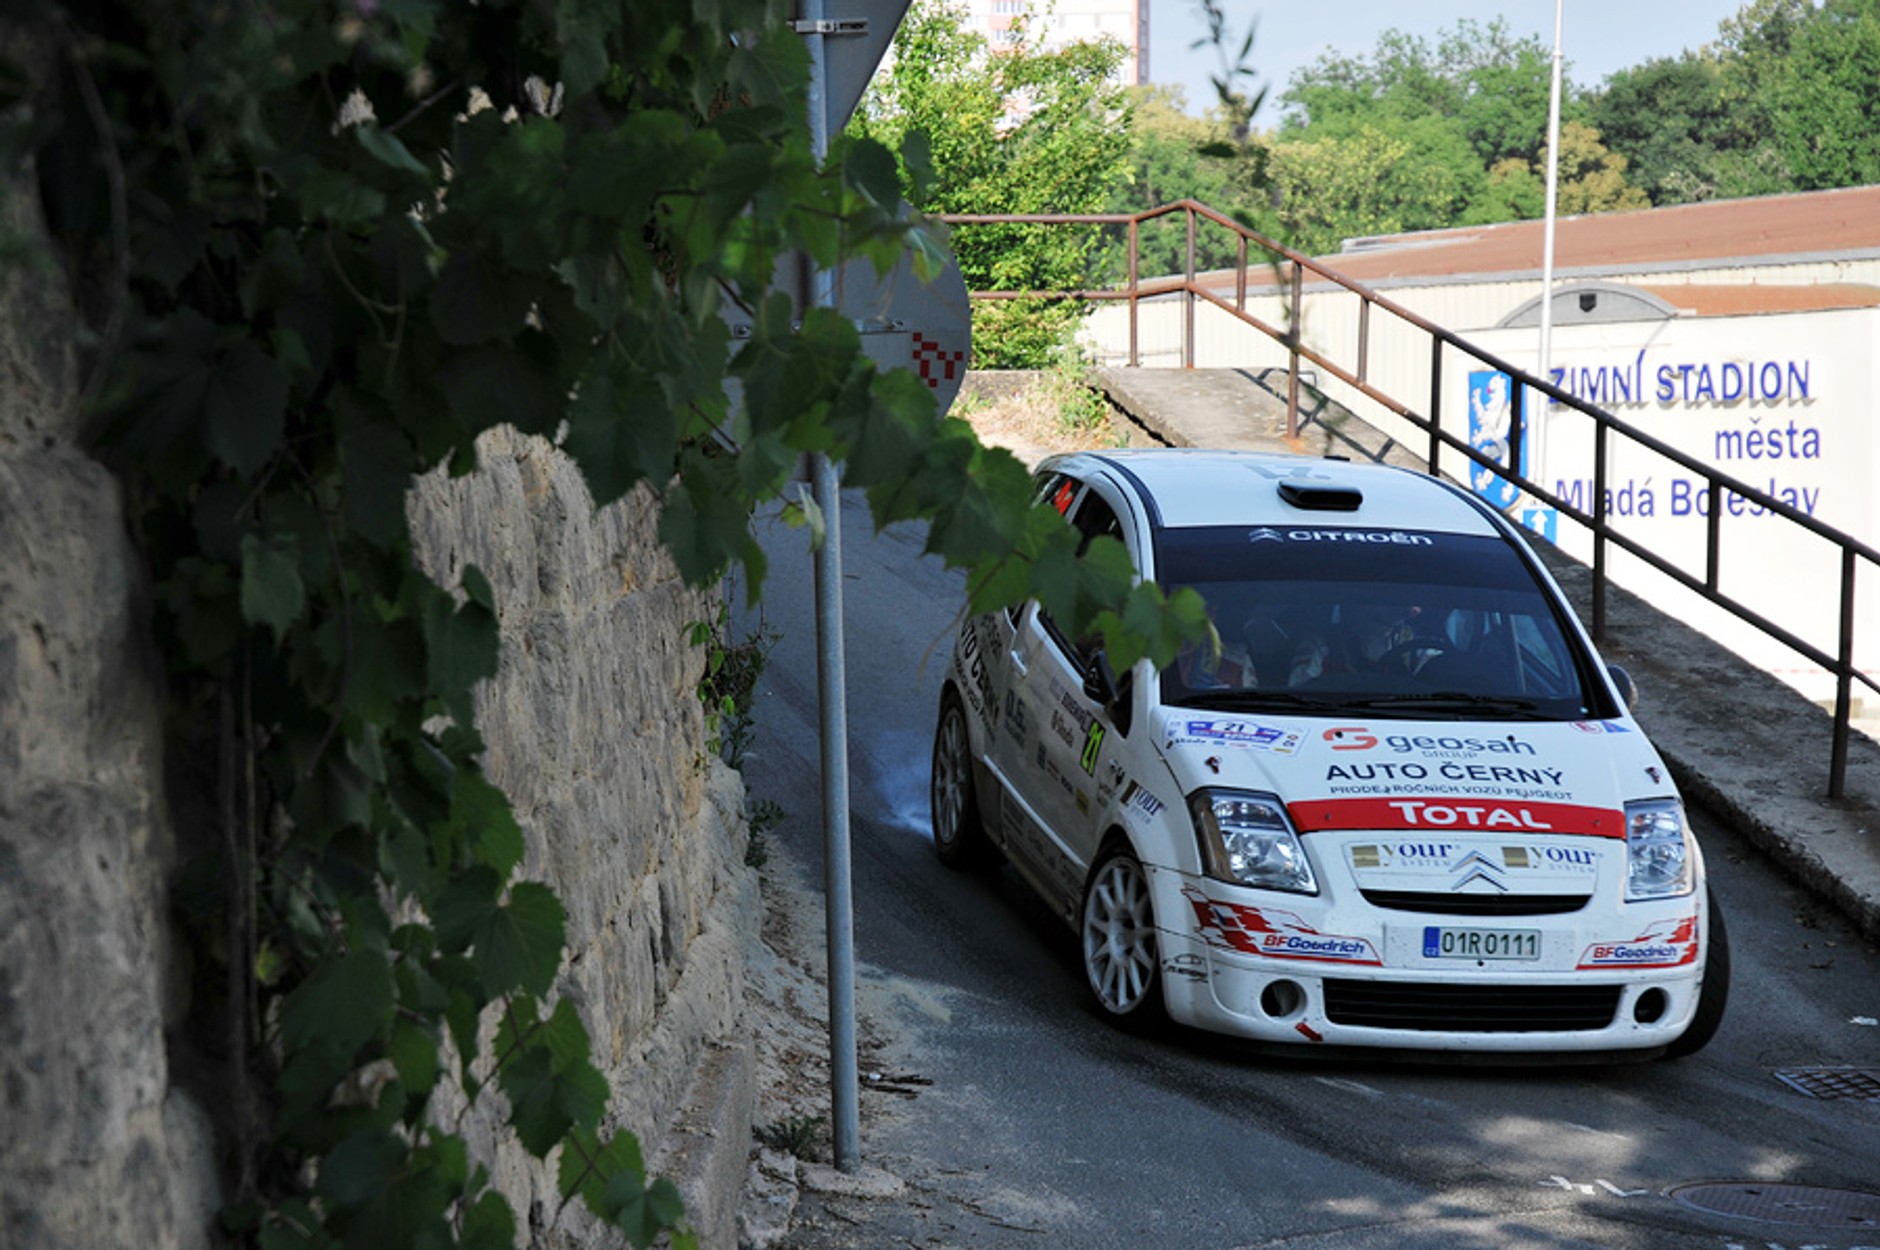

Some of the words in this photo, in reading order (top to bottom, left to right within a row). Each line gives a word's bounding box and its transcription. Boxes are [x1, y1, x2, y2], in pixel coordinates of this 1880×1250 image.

[1549, 348, 1645, 403] ZIMNÍ
[1656, 359, 1810, 401] STADION
[1715, 417, 1820, 459] města
[1224, 722, 1245, 732] 21
[1326, 763, 1428, 780] AUTO
[1440, 761, 1563, 786] ČERNÝ
[1388, 801, 1552, 829] TOTAL
[1381, 844, 1453, 867] your
[1530, 846, 1597, 869] your
[1263, 934, 1365, 954] BFGoodrich
[1593, 945, 1678, 959] BFGoodrich
